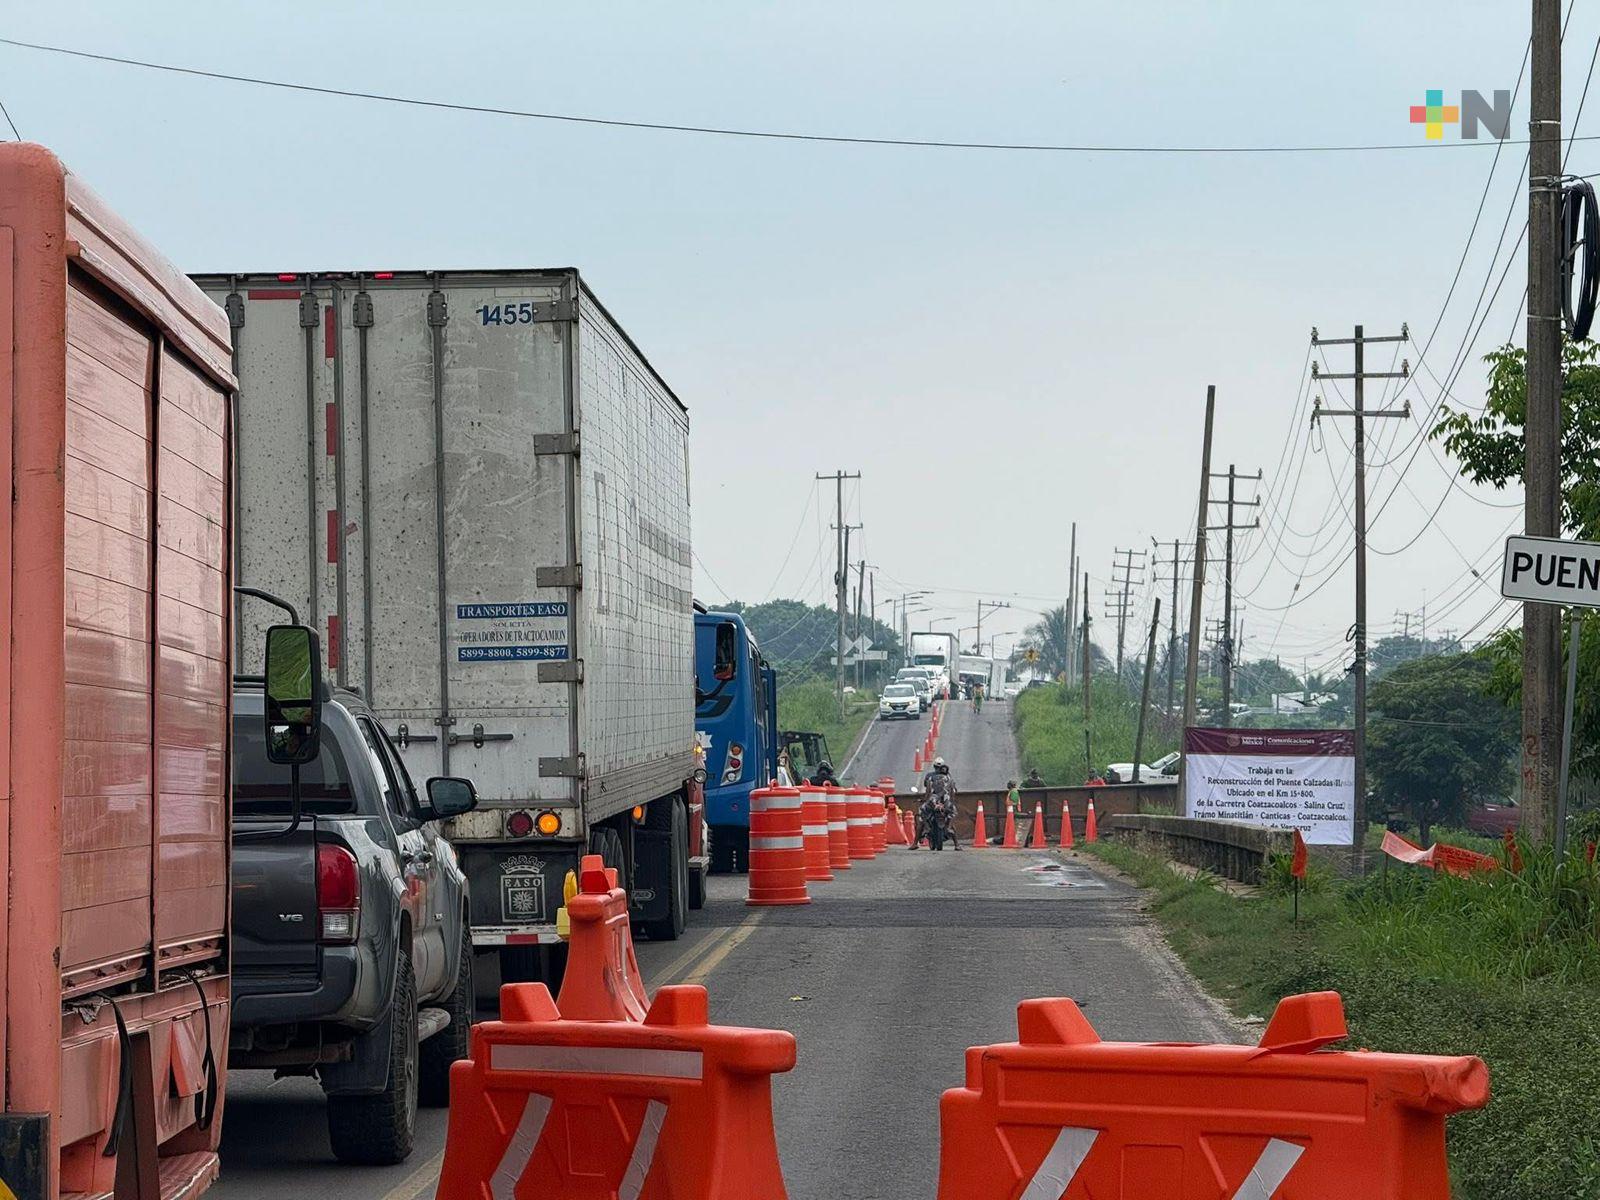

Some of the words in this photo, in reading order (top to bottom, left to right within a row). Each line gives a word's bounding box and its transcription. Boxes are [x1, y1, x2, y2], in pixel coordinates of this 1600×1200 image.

[476, 303, 532, 325] 1455
[1511, 551, 1600, 591] PUEN
[460, 605, 535, 617] TRANSPORTES
[538, 604, 565, 616] EASO
[460, 630, 504, 643] OPERADORES
[505, 630, 511, 642] DE
[512, 629, 566, 642] TRACTOCAMION
[516, 647, 566, 657] 5899-8877
[1247, 766, 1273, 776] Trabaja
[1207, 777, 1262, 785] Reconstrucción
[1263, 777, 1275, 786] del
[1276, 778, 1302, 786] Puente
[1303, 778, 1333, 787] Calzadas
[1226, 788, 1255, 797] Ubicado
[1267, 789, 1274, 797] el
[1276, 789, 1289, 797] Km
[1196, 799, 1205, 807] de
[1207, 799, 1213, 807] la
[1247, 800, 1298, 809] Coatzacoalcos
[1304, 801, 1325, 809] Salina
[1193, 810, 1216, 818] Tramo
[1217, 810, 1254, 819] Minatitlán
[1260, 811, 1291, 820] Canticas
[504, 878, 541, 888] EASO
